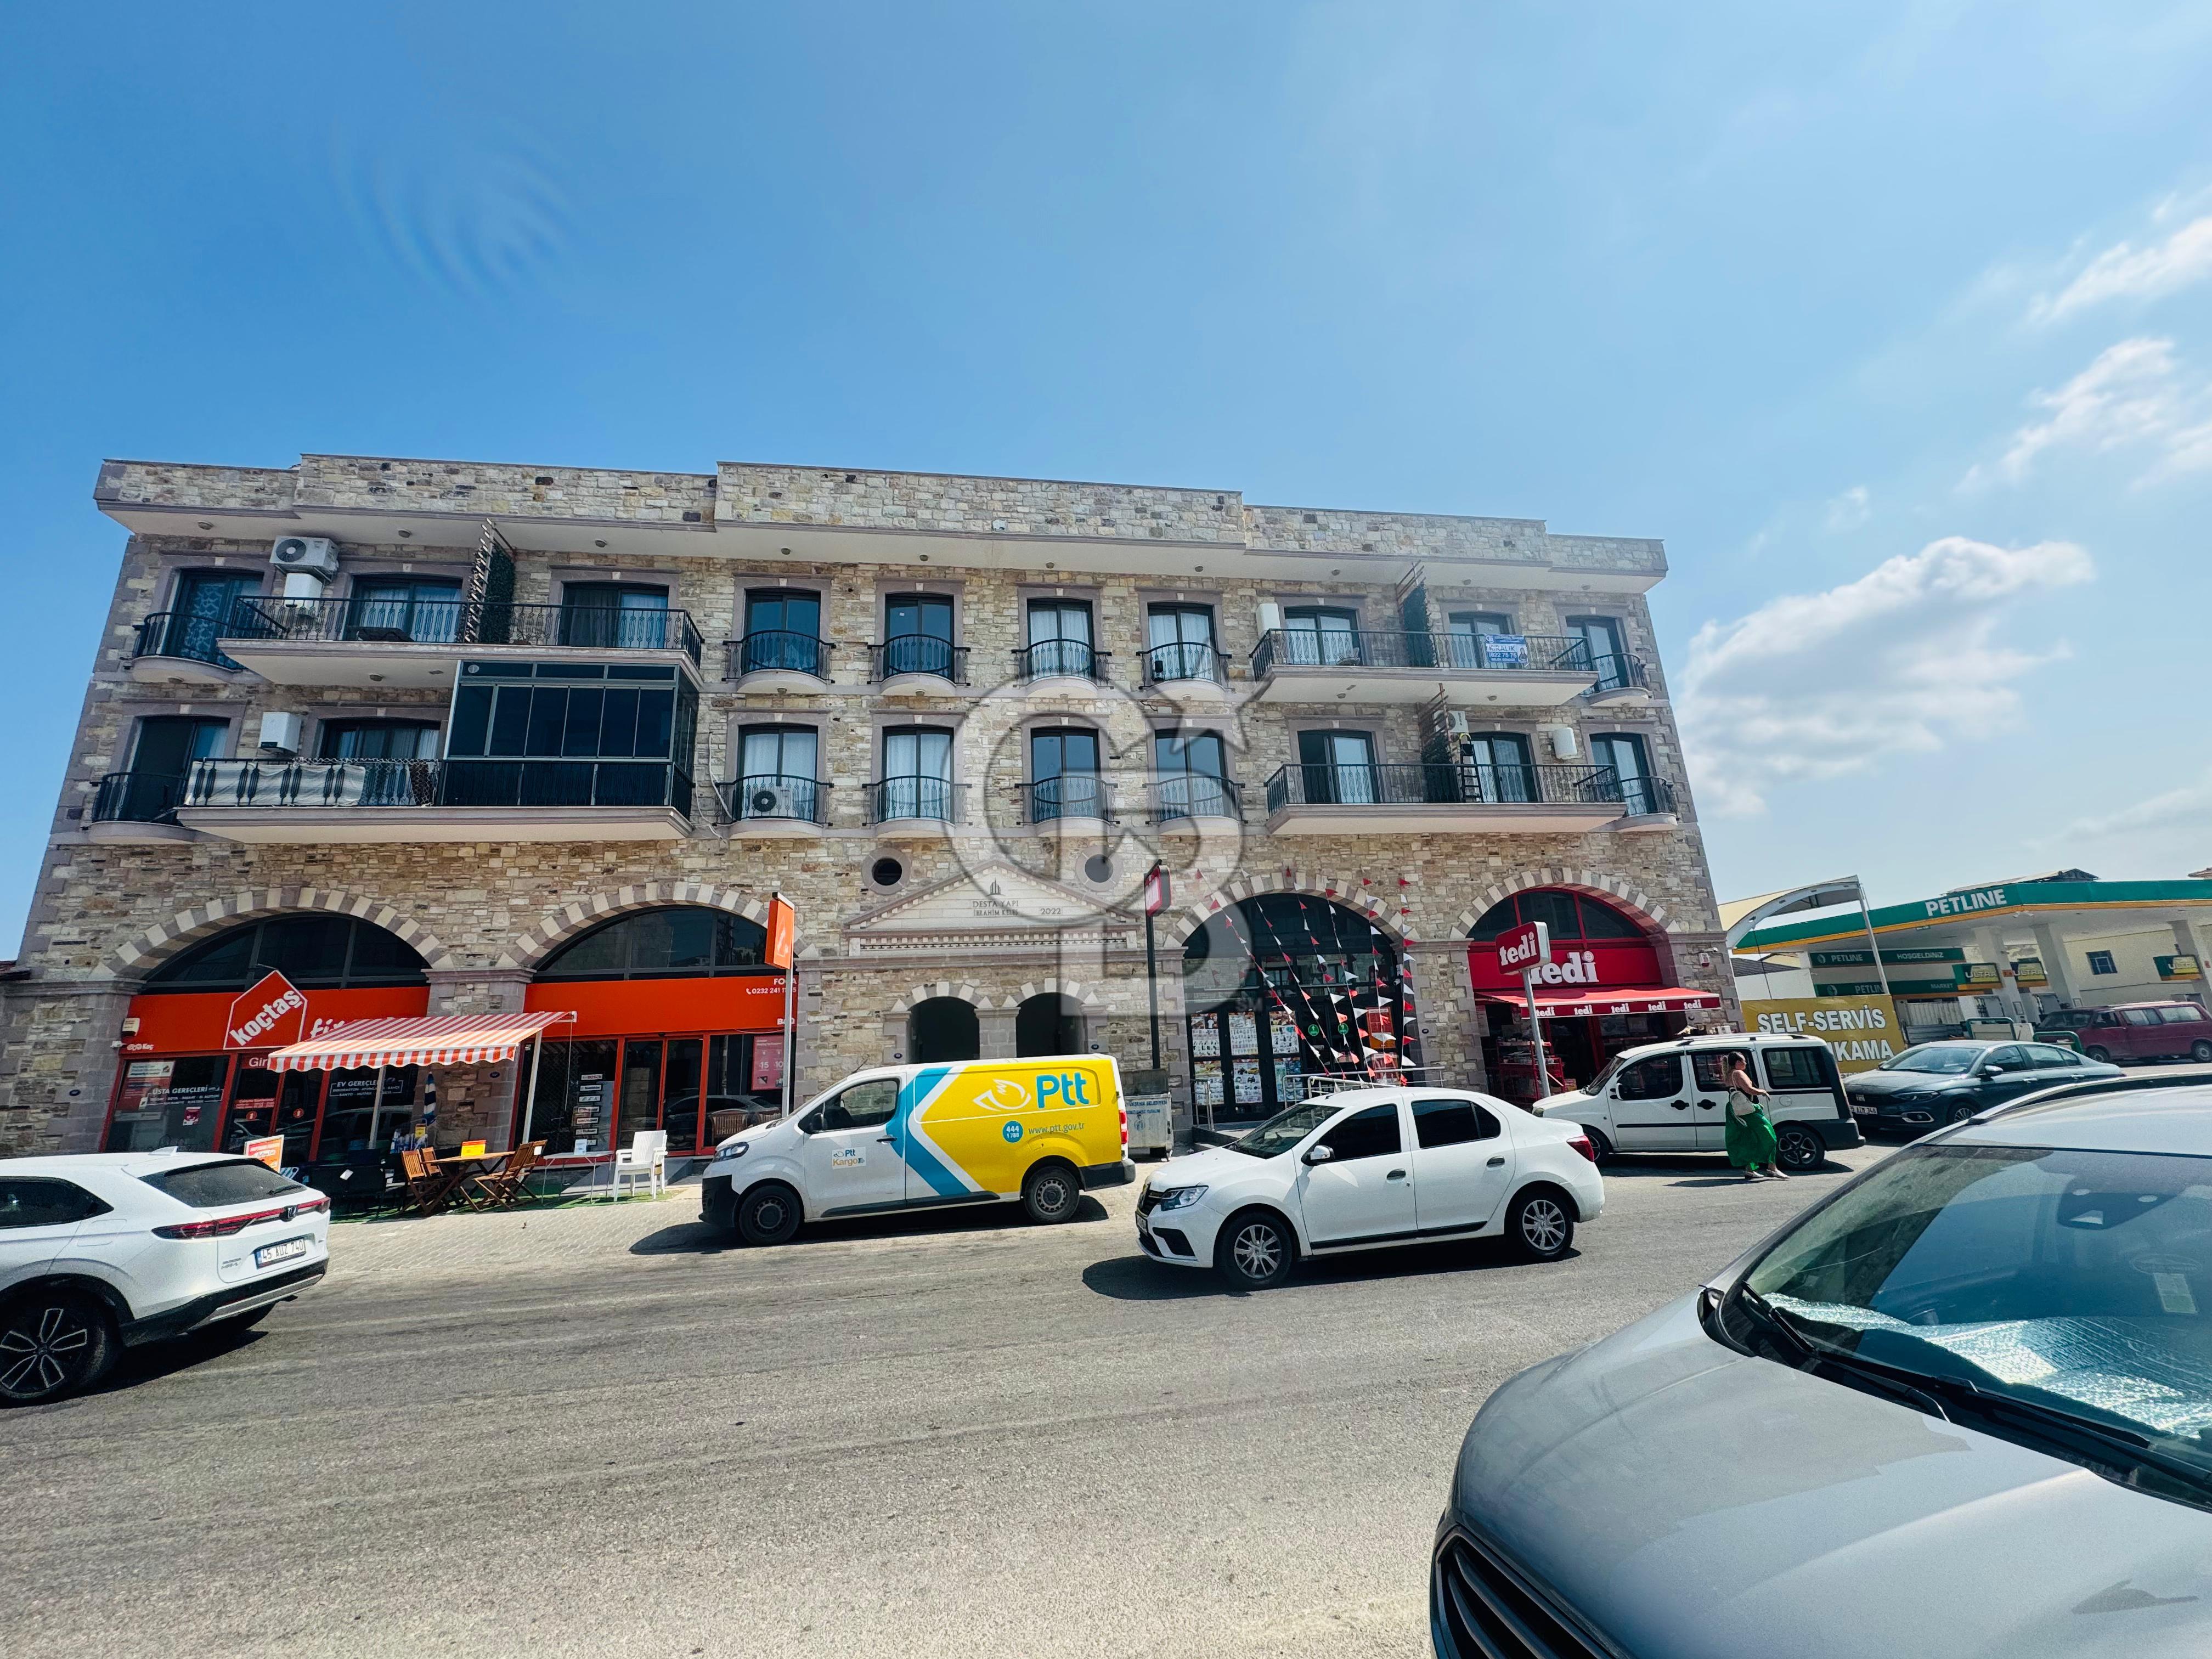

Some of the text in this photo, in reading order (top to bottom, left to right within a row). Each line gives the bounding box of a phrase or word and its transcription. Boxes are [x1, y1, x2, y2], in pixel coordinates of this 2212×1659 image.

[1925, 889, 2007, 917] PETLINE
[1499, 932, 1537, 966] tedi
[1831, 954, 1864, 962] PETLINE
[1854, 984, 1886, 994] PETLIN
[1611, 1003, 1630, 1013] tedi
[1647, 1001, 1667, 1011] tedi
[1684, 999, 1702, 1009] tedi
[1574, 1005, 1593, 1015] tedi
[229, 990, 303, 1046] koçtaş
[1757, 1005, 1886, 1033] SELF-SERVİS
[249, 1058, 268, 1067] Gir
[172, 1085, 208, 1094] GEREÇLERİ
[1036, 1072, 1090, 1109] Ptt
[1028, 1122, 1085, 1135] www.ptt.gov.tr
[845, 1149, 855, 1157] Ptt
[833, 1158, 857, 1166] Kargo
[262, 1249, 272, 1260] 45
[291, 1240, 304, 1252] 740
